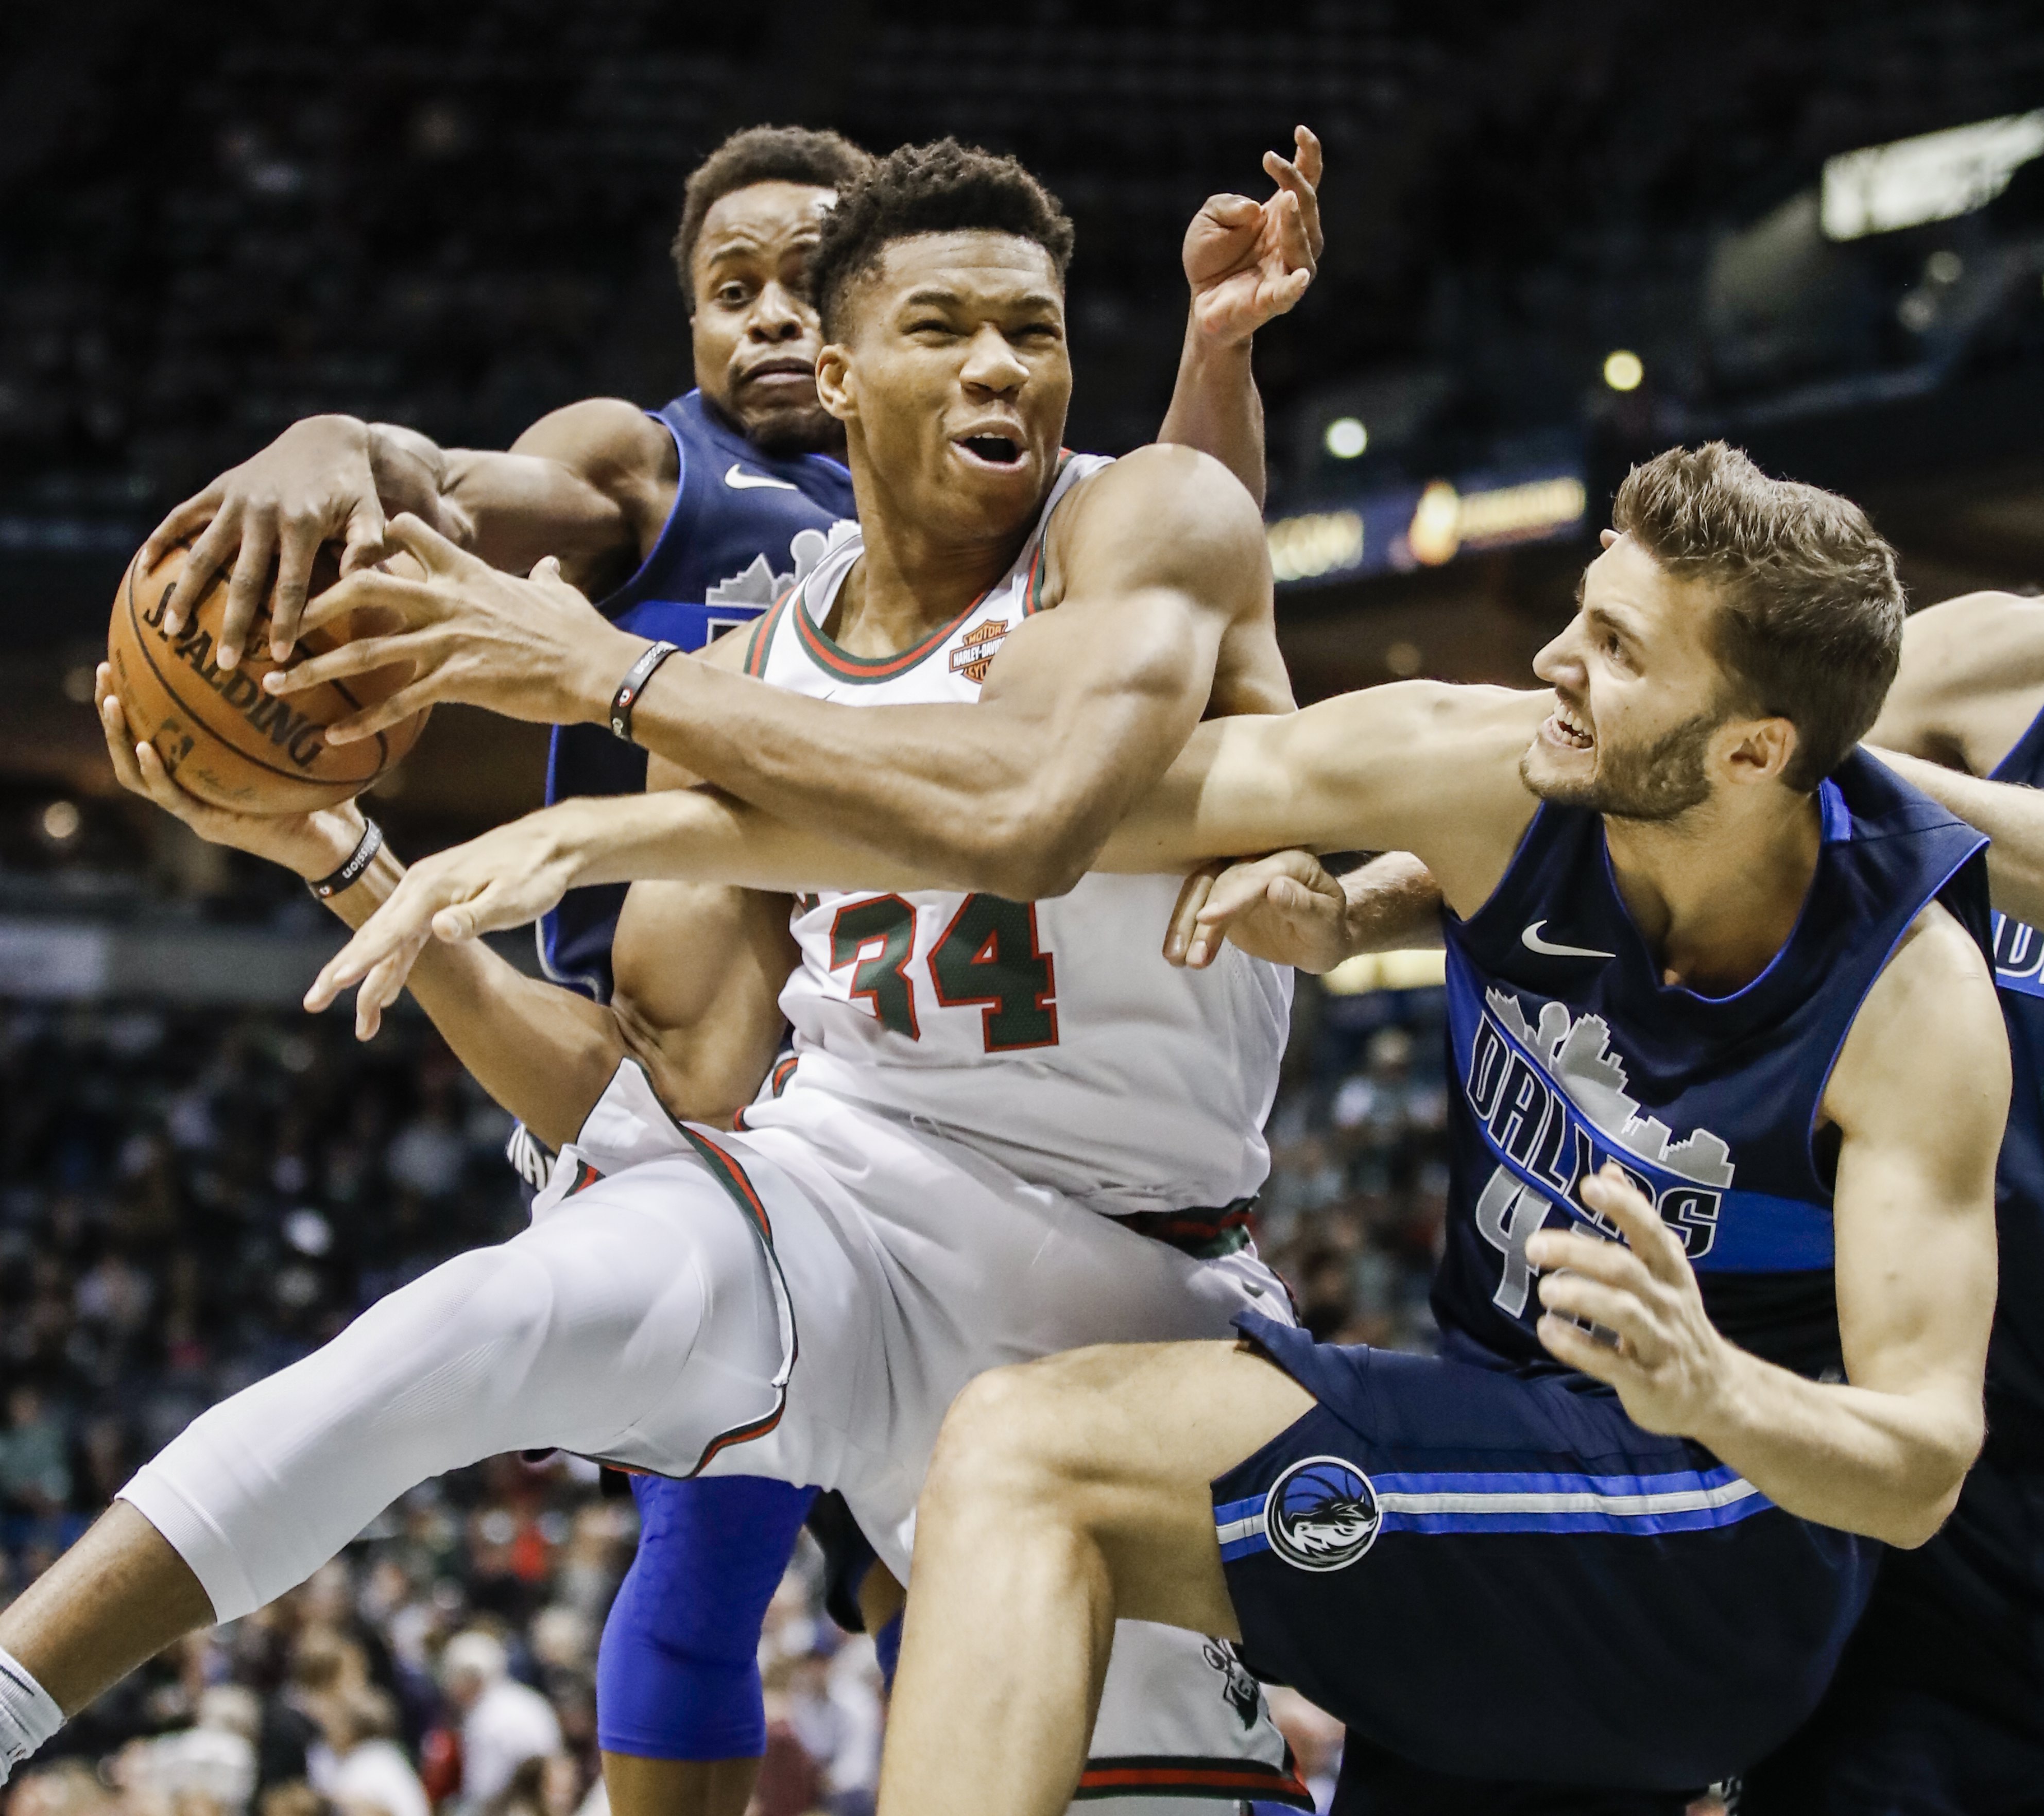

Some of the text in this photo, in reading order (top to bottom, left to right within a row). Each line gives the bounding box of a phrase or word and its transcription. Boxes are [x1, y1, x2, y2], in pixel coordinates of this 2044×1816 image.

[953, 636, 1005, 668] HARLEY-DAVID
[969, 625, 1002, 644] MOTOR
[830, 893, 1059, 1053] 34
[1993, 913, 2044, 984] D
